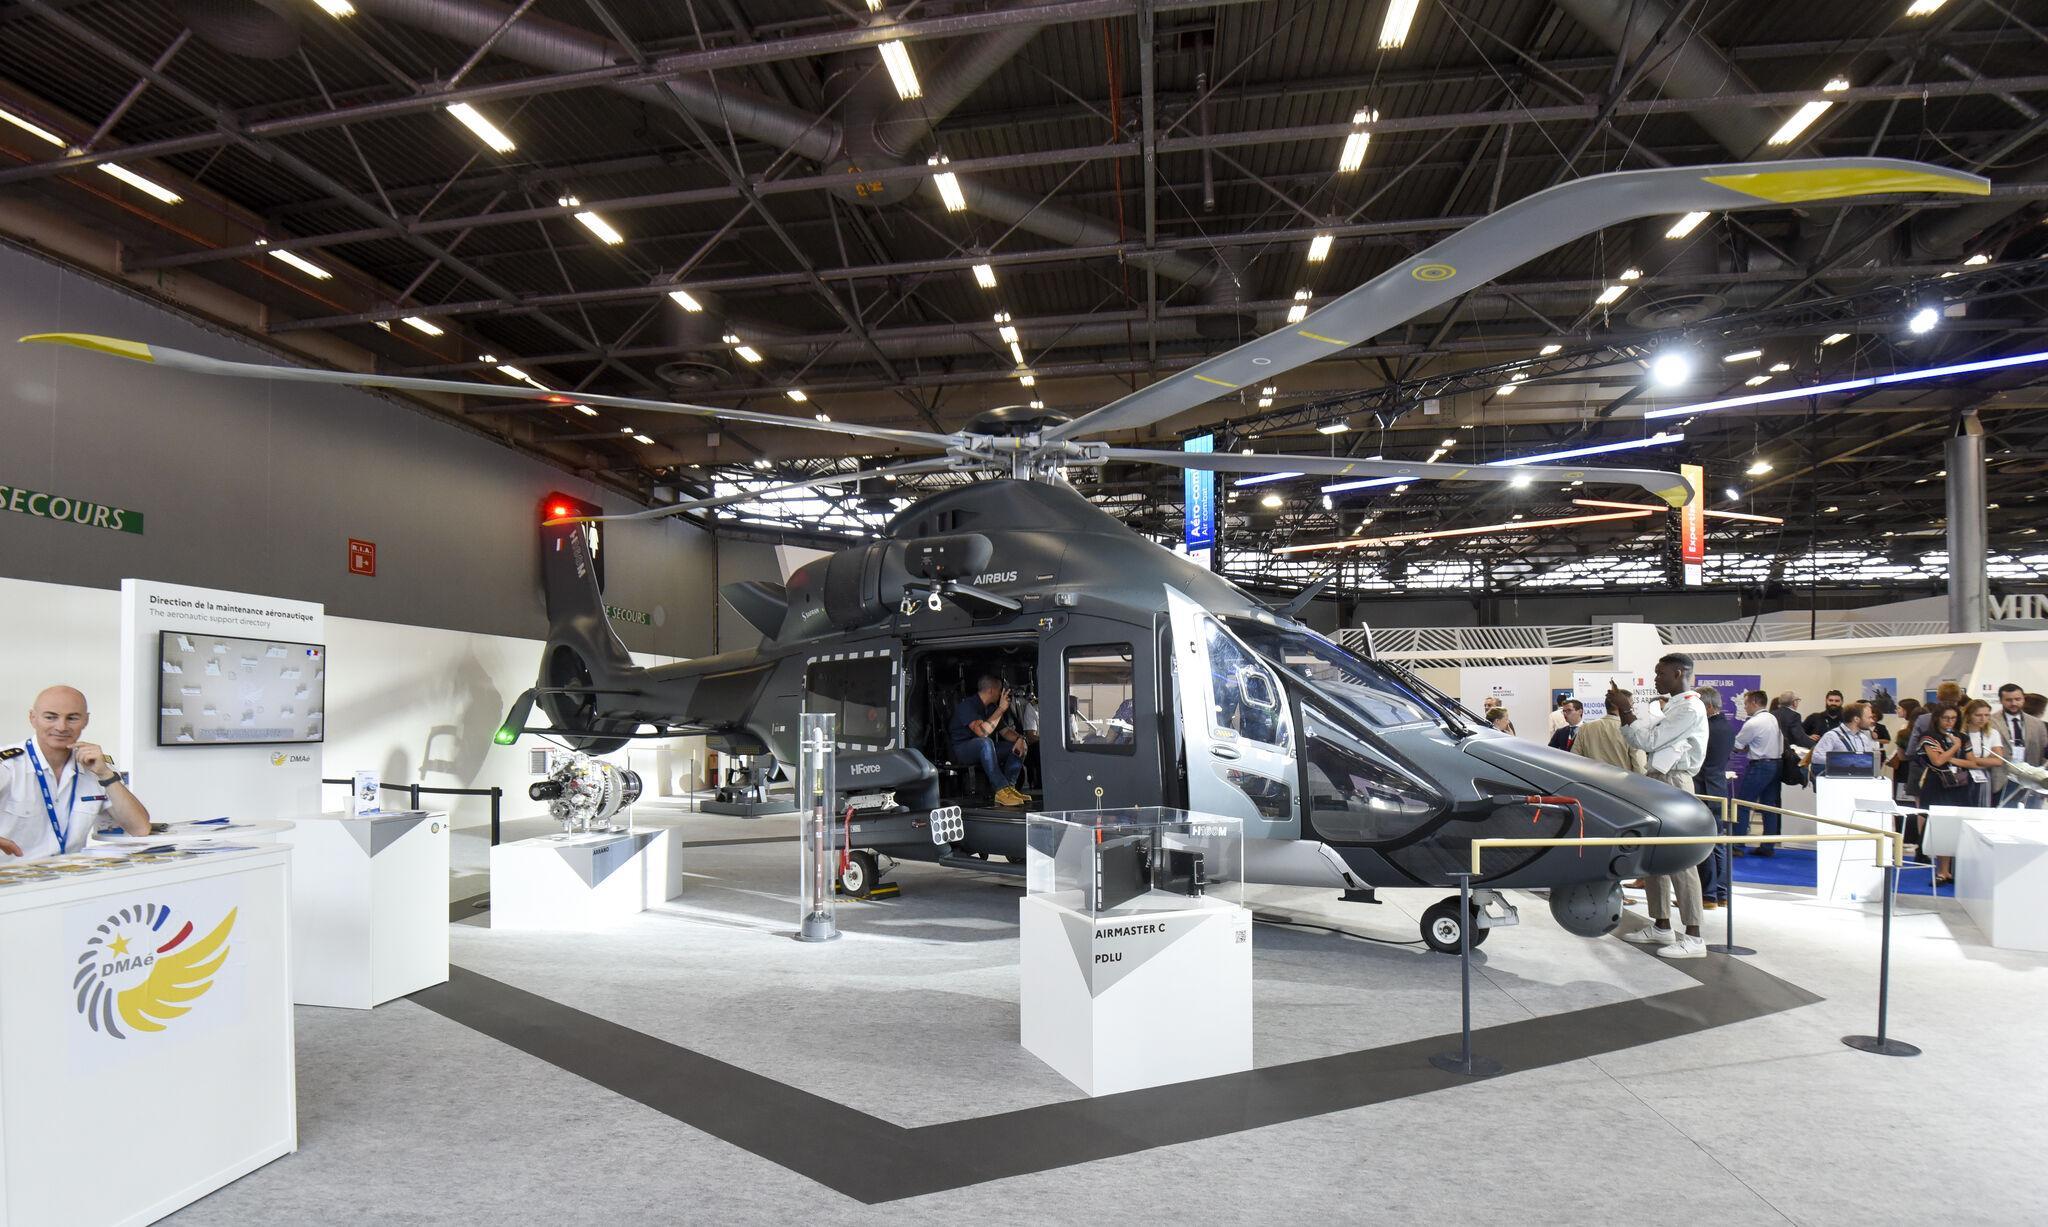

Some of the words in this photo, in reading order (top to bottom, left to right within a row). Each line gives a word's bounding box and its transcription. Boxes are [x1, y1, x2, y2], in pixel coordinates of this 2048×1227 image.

[973, 571, 1018, 585] AIRBUS
[149, 595, 193, 608] Direction
[194, 602, 205, 610] de
[216, 603, 264, 616] maintenance
[265, 608, 314, 622] aéronautique
[611, 606, 646, 624] SECOURS
[149, 608, 165, 617] The
[166, 611, 208, 622] aeronautic
[209, 616, 238, 626] support
[239, 618, 271, 629] directory
[1095, 925, 1156, 939] AIRMASTER
[1158, 923, 1166, 932] C
[101, 953, 154, 978] DMAé
[1095, 952, 1123, 964] PDLU
